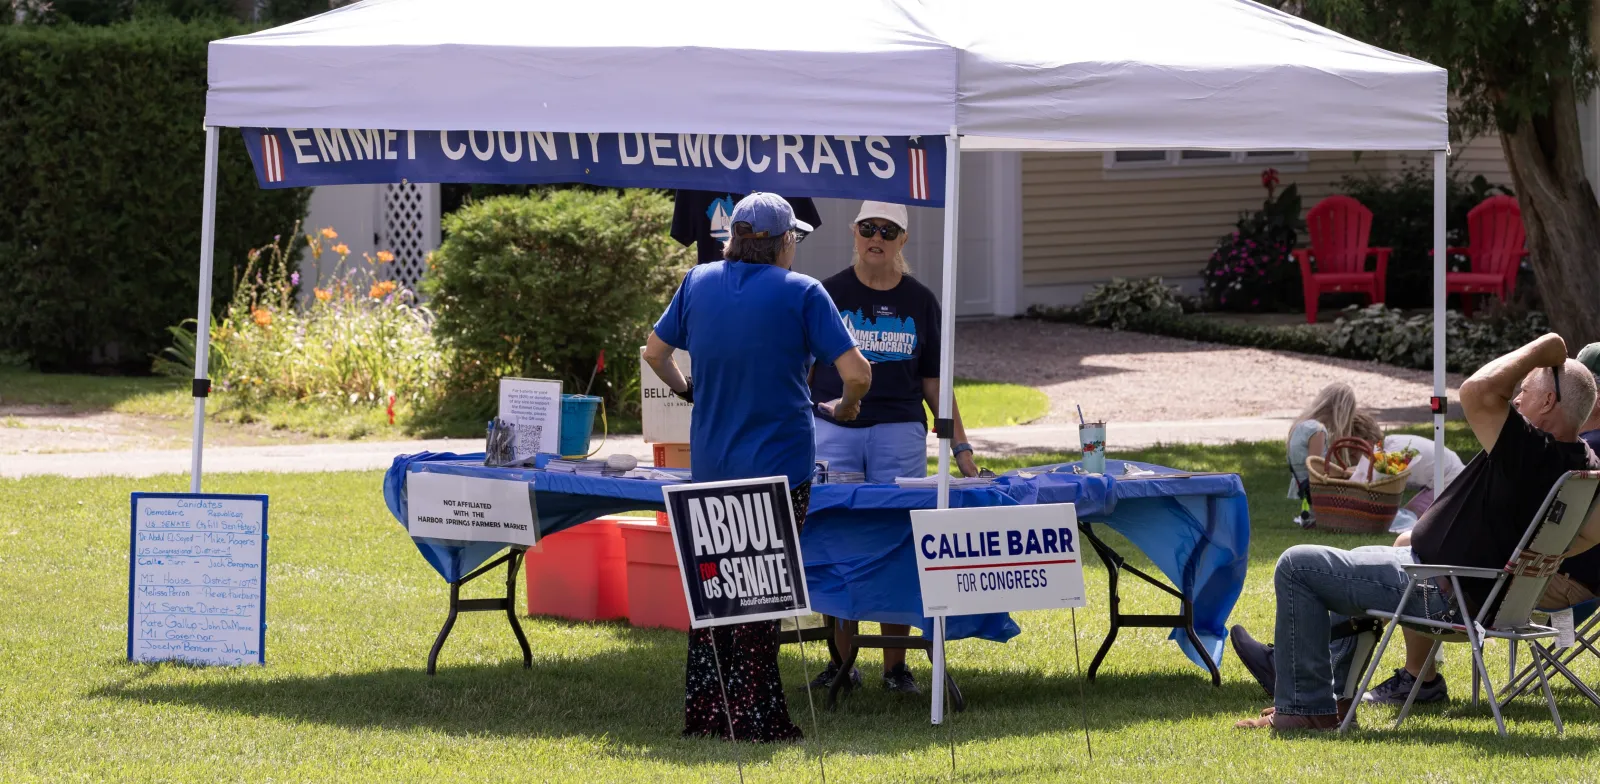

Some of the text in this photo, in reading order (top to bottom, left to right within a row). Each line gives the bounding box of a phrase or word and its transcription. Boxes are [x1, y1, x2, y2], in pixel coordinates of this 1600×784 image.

[285, 128, 896, 180] EMMET COUNTY DEMOCRATS
[852, 329, 915, 345] MMET COUNTY
[858, 340, 913, 355] DEMOCRATS
[644, 387, 675, 399] BELLA
[457, 501, 492, 510] AFFILIATED
[418, 516, 528, 531] HARBOR SPRINGS FARMERS MARKET
[688, 492, 784, 556] ABDUL
[921, 528, 1074, 560] CALLIE BARR
[163, 572, 191, 584] House
[700, 562, 718, 580] FOR
[703, 553, 792, 600] US SENATE
[956, 568, 1048, 592] FOR CONGRESS
[162, 602, 196, 613] Senate
[740, 595, 792, 607] AbdulForSenate.com
